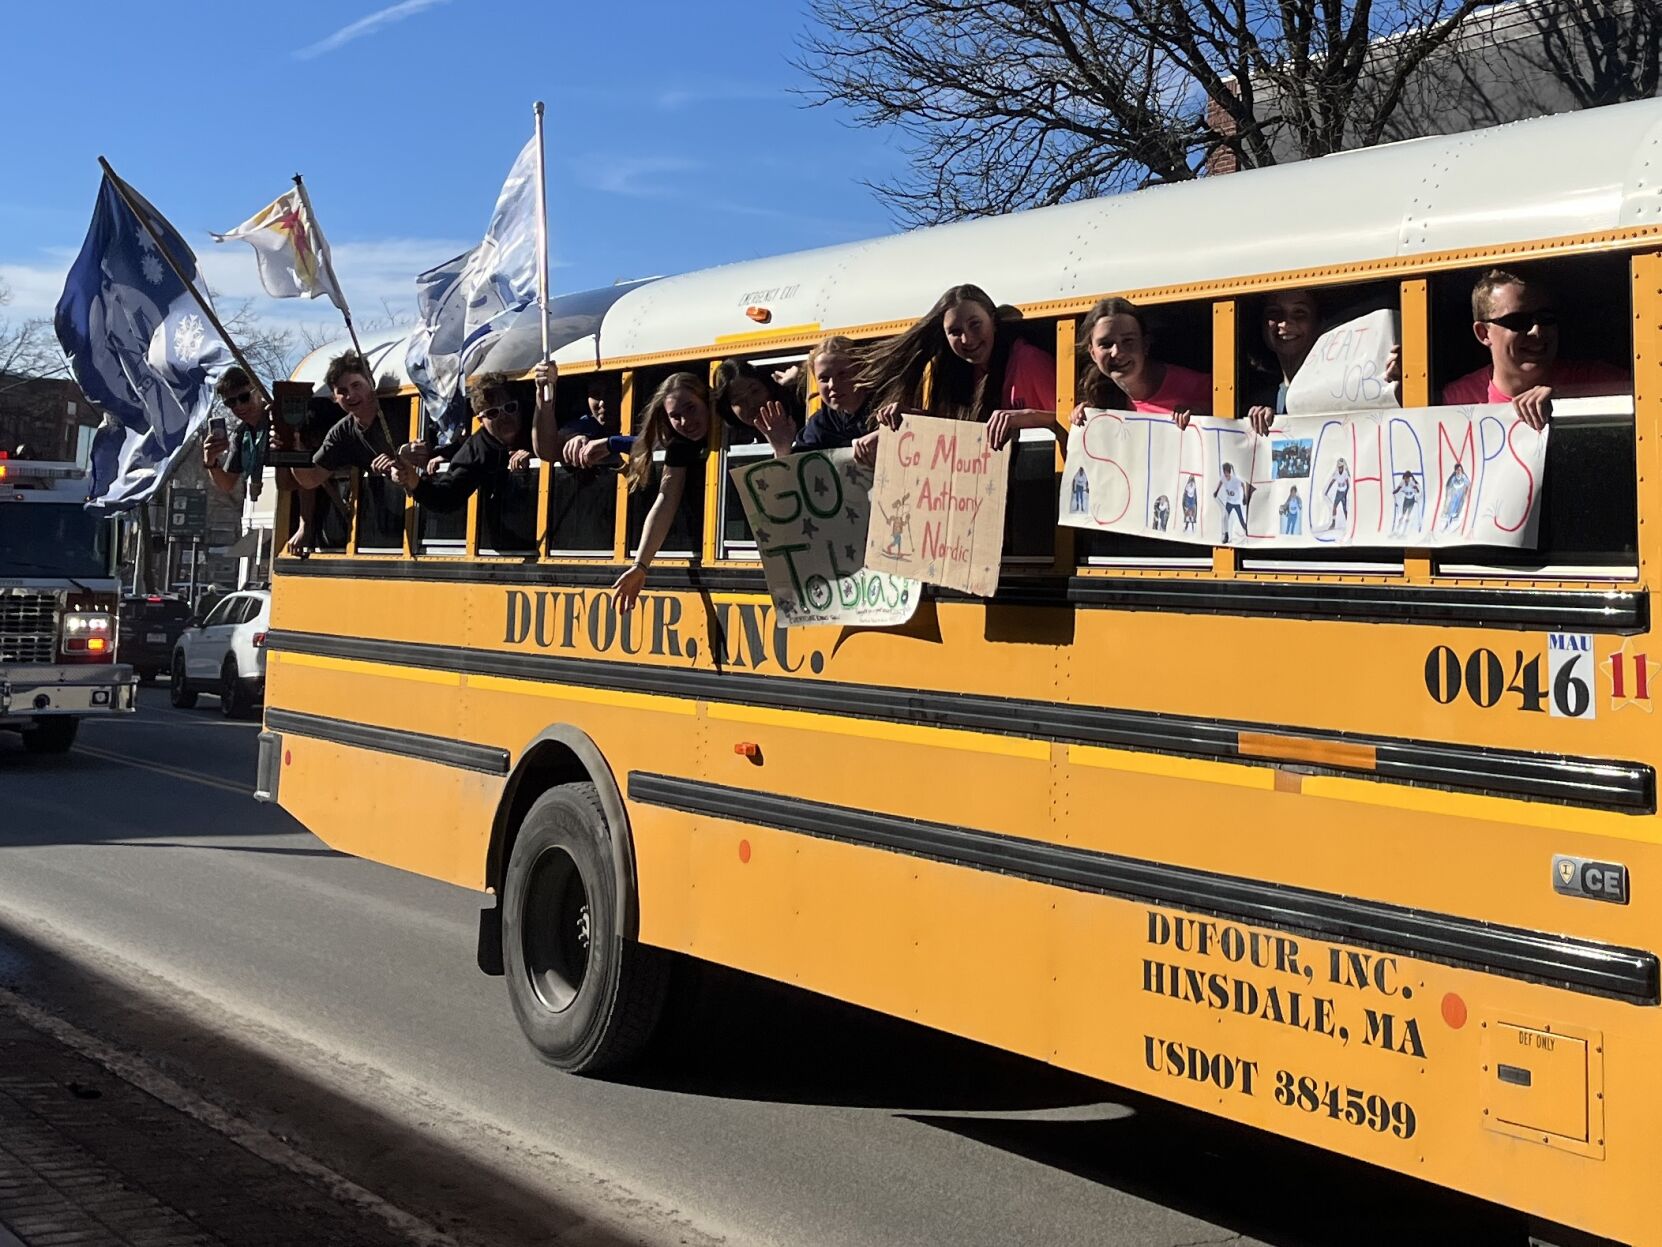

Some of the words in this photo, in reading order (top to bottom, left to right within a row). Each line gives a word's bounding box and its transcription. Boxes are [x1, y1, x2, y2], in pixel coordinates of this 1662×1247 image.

[1330, 359, 1382, 402] JOB
[897, 431, 921, 468] Go
[930, 434, 992, 475] Mount
[744, 452, 843, 525] GO
[916, 477, 984, 524] Anthony
[1309, 415, 1534, 543] CHAMPS
[921, 521, 970, 562] Nordic
[503, 590, 698, 667] DUFOUR,
[709, 602, 825, 675] INC.
[1549, 634, 1592, 651] MAU
[1610, 652, 1651, 700] 11
[1585, 868, 1621, 895] CE
[1146, 911, 1314, 985] DUFOUR,
[1328, 947, 1413, 1000] INC.
[1142, 959, 1350, 1047] HINSDALE,
[1361, 1008, 1428, 1060] MA
[1518, 1030, 1533, 1047] DEF
[1536, 1034, 1556, 1052] ONLY
[1143, 1035, 1259, 1097] USDOT
[1274, 1069, 1417, 1141] 384599
